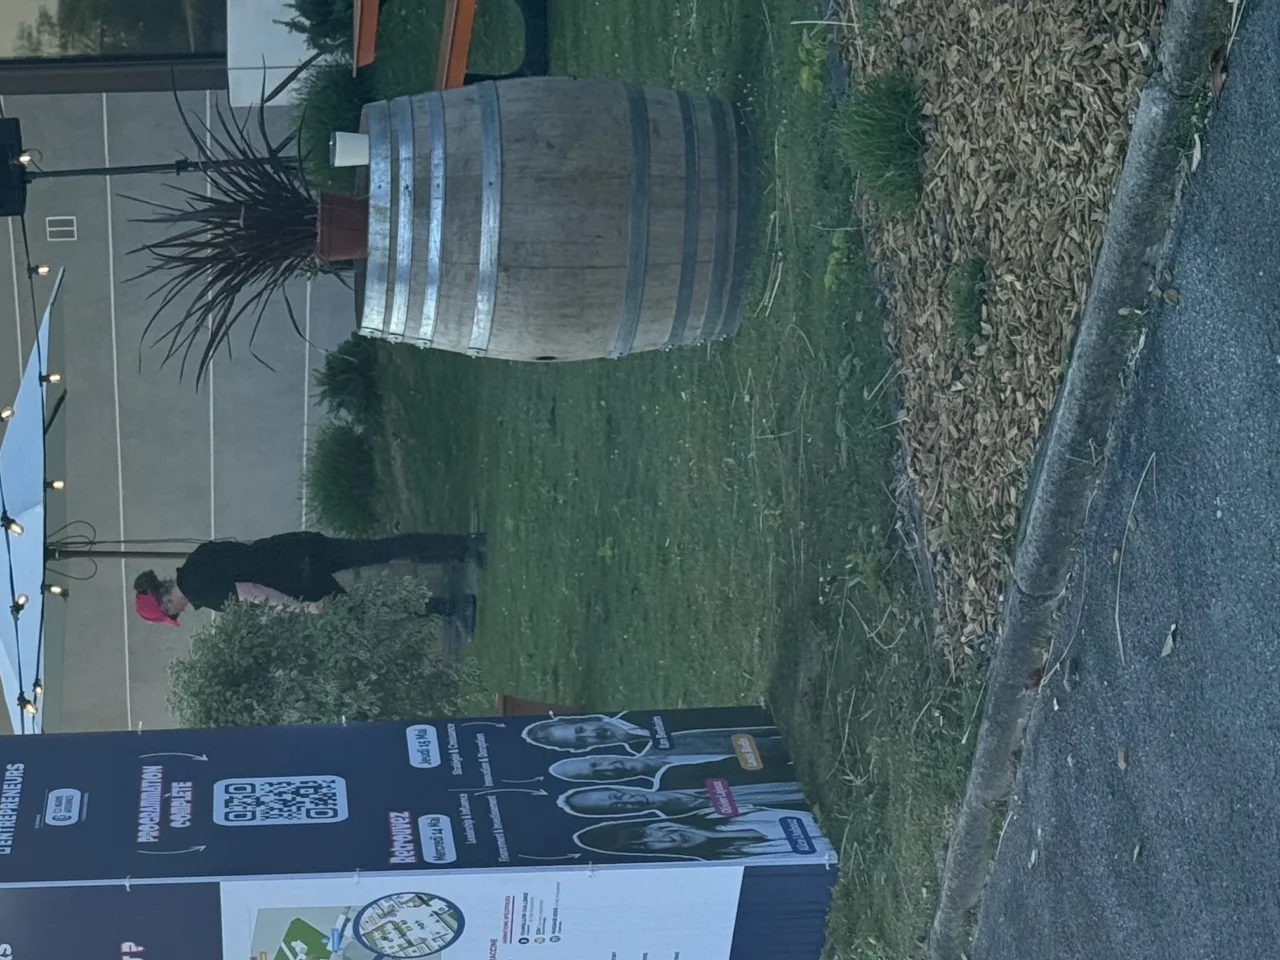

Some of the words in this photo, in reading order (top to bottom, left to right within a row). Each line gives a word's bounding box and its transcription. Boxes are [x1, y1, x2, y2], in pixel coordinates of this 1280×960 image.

[414, 728, 428, 740] Mai
[418, 740, 431, 748] 15
[418, 748, 432, 766] Jeudi
[136, 765, 162, 842] PROGRAMMATION
[165, 781, 192, 828] COMPLÈTE
[426, 816, 441, 828] Mai
[389, 811, 416, 864] Retrouvez
[429, 836, 447, 861] Mercredi
[121, 942, 144, 952] ?
